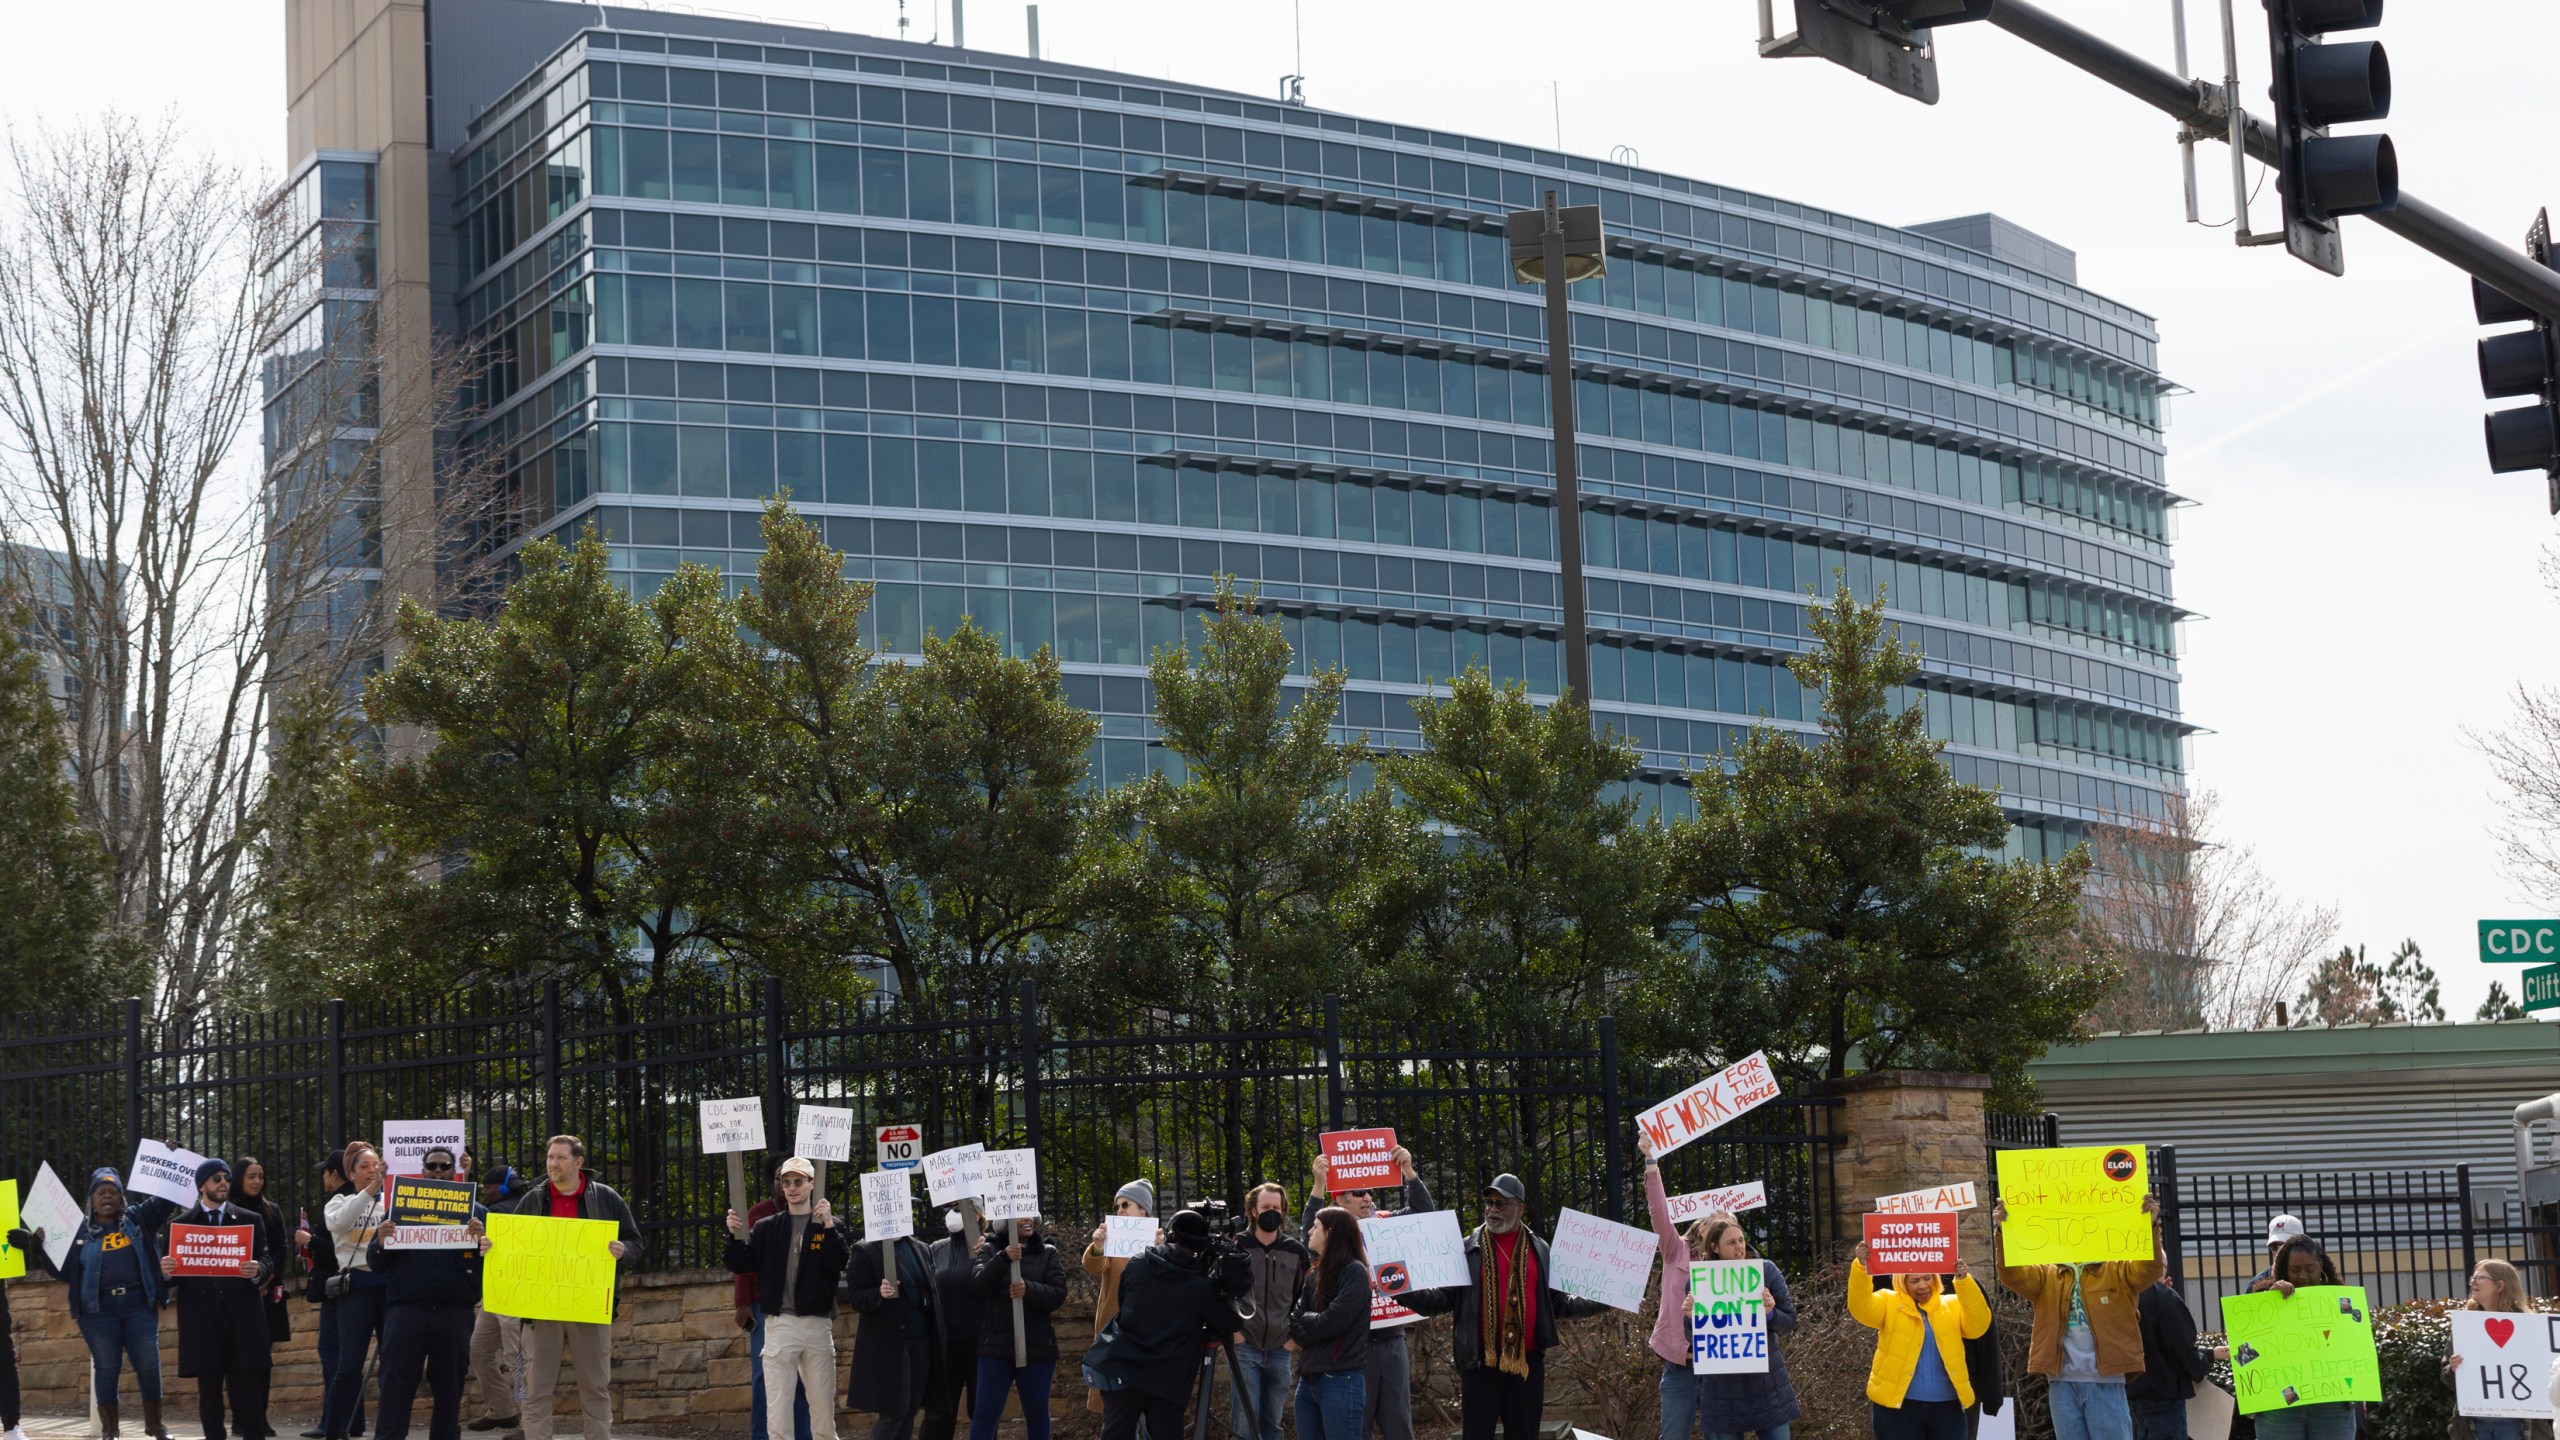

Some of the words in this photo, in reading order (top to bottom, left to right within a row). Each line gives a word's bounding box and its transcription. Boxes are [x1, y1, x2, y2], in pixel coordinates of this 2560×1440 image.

[2487, 928, 2555, 954] CDC
[1725, 1057, 1764, 1083] FOR
[1728, 1071, 1765, 1093] THE
[1733, 1081, 1776, 1111] PEOPLE
[707, 1105, 727, 1116] CDC
[1640, 1106, 1681, 1151] WE
[1673, 1082, 1732, 1136] WORK
[707, 1121, 725, 1130] WORK
[730, 1119, 744, 1128] FOR
[800, 1112, 851, 1130] ELIMINATION
[388, 1136, 433, 1145] WORKERS
[435, 1135, 459, 1143] OVER
[716, 1128, 754, 1144] AMERICA!
[1337, 1139, 1364, 1151] STOP
[1366, 1138, 1386, 1150] THE
[798, 1142, 847, 1160] EFFICIENCY!
[887, 1143, 912, 1160] NO
[988, 1155, 1010, 1166] THIS
[1015, 1153, 1023, 1162] IS
[139, 1154, 178, 1170] WORKERS
[178, 1165, 197, 1178] OVE
[885, 1160, 915, 1168] TRESPASSING
[929, 1154, 953, 1171] MAKE
[2022, 1157, 2100, 1182] PROTECT
[2107, 1161, 2133, 1170] ELON
[140, 1165, 192, 1189] BILLIONAIRES!
[870, 1172, 904, 1188] PROTECT
[987, 1167, 1021, 1179] ILLEGAL
[1336, 1165, 1390, 1179] TAKEOVER
[932, 1175, 956, 1193] GREAT
[962, 1172, 983, 1183] AGAIN
[997, 1180, 1011, 1192] AF
[1017, 1181, 1030, 1190] and
[397, 1185, 415, 1196] OUR
[417, 1187, 470, 1202] DEMOCRACY
[868, 1188, 903, 1204] PUBLIC
[987, 1195, 997, 1203] not
[1723, 1191, 1745, 1211] HEALTH
[1734, 1194, 1763, 1211] WORKER
[1934, 1187, 1972, 1210] ALL
[395, 1197, 405, 1207] IS
[406, 1198, 435, 1210] UNDER
[436, 1201, 470, 1213] ATTACK
[873, 1202, 904, 1216] HEALTH
[992, 1203, 1011, 1217] VERY
[1016, 1200, 1037, 1213] RUDE!
[1668, 1196, 1697, 1220] JESUS
[877, 1225, 900, 1236] SUFFER
[1112, 1217, 1146, 1231] DUE
[1366, 1218, 1426, 1242] Deport
[1881, 1223, 1914, 1235] STOP
[1916, 1222, 1941, 1234] THE
[185, 1233, 215, 1244] STOP
[217, 1234, 239, 1244] THE
[386, 1227, 439, 1246] SOLIDARITY
[494, 1216, 619, 1257] PROTECT
[1562, 1210, 1613, 1243] President
[1616, 1229, 1657, 1257] Muskrat
[1872, 1236, 1950, 1249] BILLIONAIRE
[2017, 1216, 2099, 1251] STOP
[176, 1245, 246, 1256] BILLIONAIRE
[1419, 1232, 1460, 1256] Musk
[1559, 1239, 1585, 1256] must
[1588, 1244, 1601, 1261] be
[181, 1257, 240, 1268] TAKEOVER
[1878, 1251, 1944, 1262] TAKEOVER
[489, 1252, 611, 1286] GOVERNMENT
[1381, 1272, 1405, 1284] ELON
[1410, 1261, 1450, 1282] NOW
[1550, 1254, 1614, 1290] Reinstate
[1691, 1265, 1761, 1296] FUND
[491, 1282, 611, 1315] WORKERS!
[1560, 1277, 1614, 1304] Workers
[1693, 1297, 1763, 1329] DON'T
[2296, 1292, 2341, 1321] ELON
[1693, 1332, 1766, 1363] FREEZE
[2239, 1364, 2303, 1398] NOBODY
[2310, 1358, 2374, 1379] ELECTED
[2480, 1363, 2532, 1401] H8
